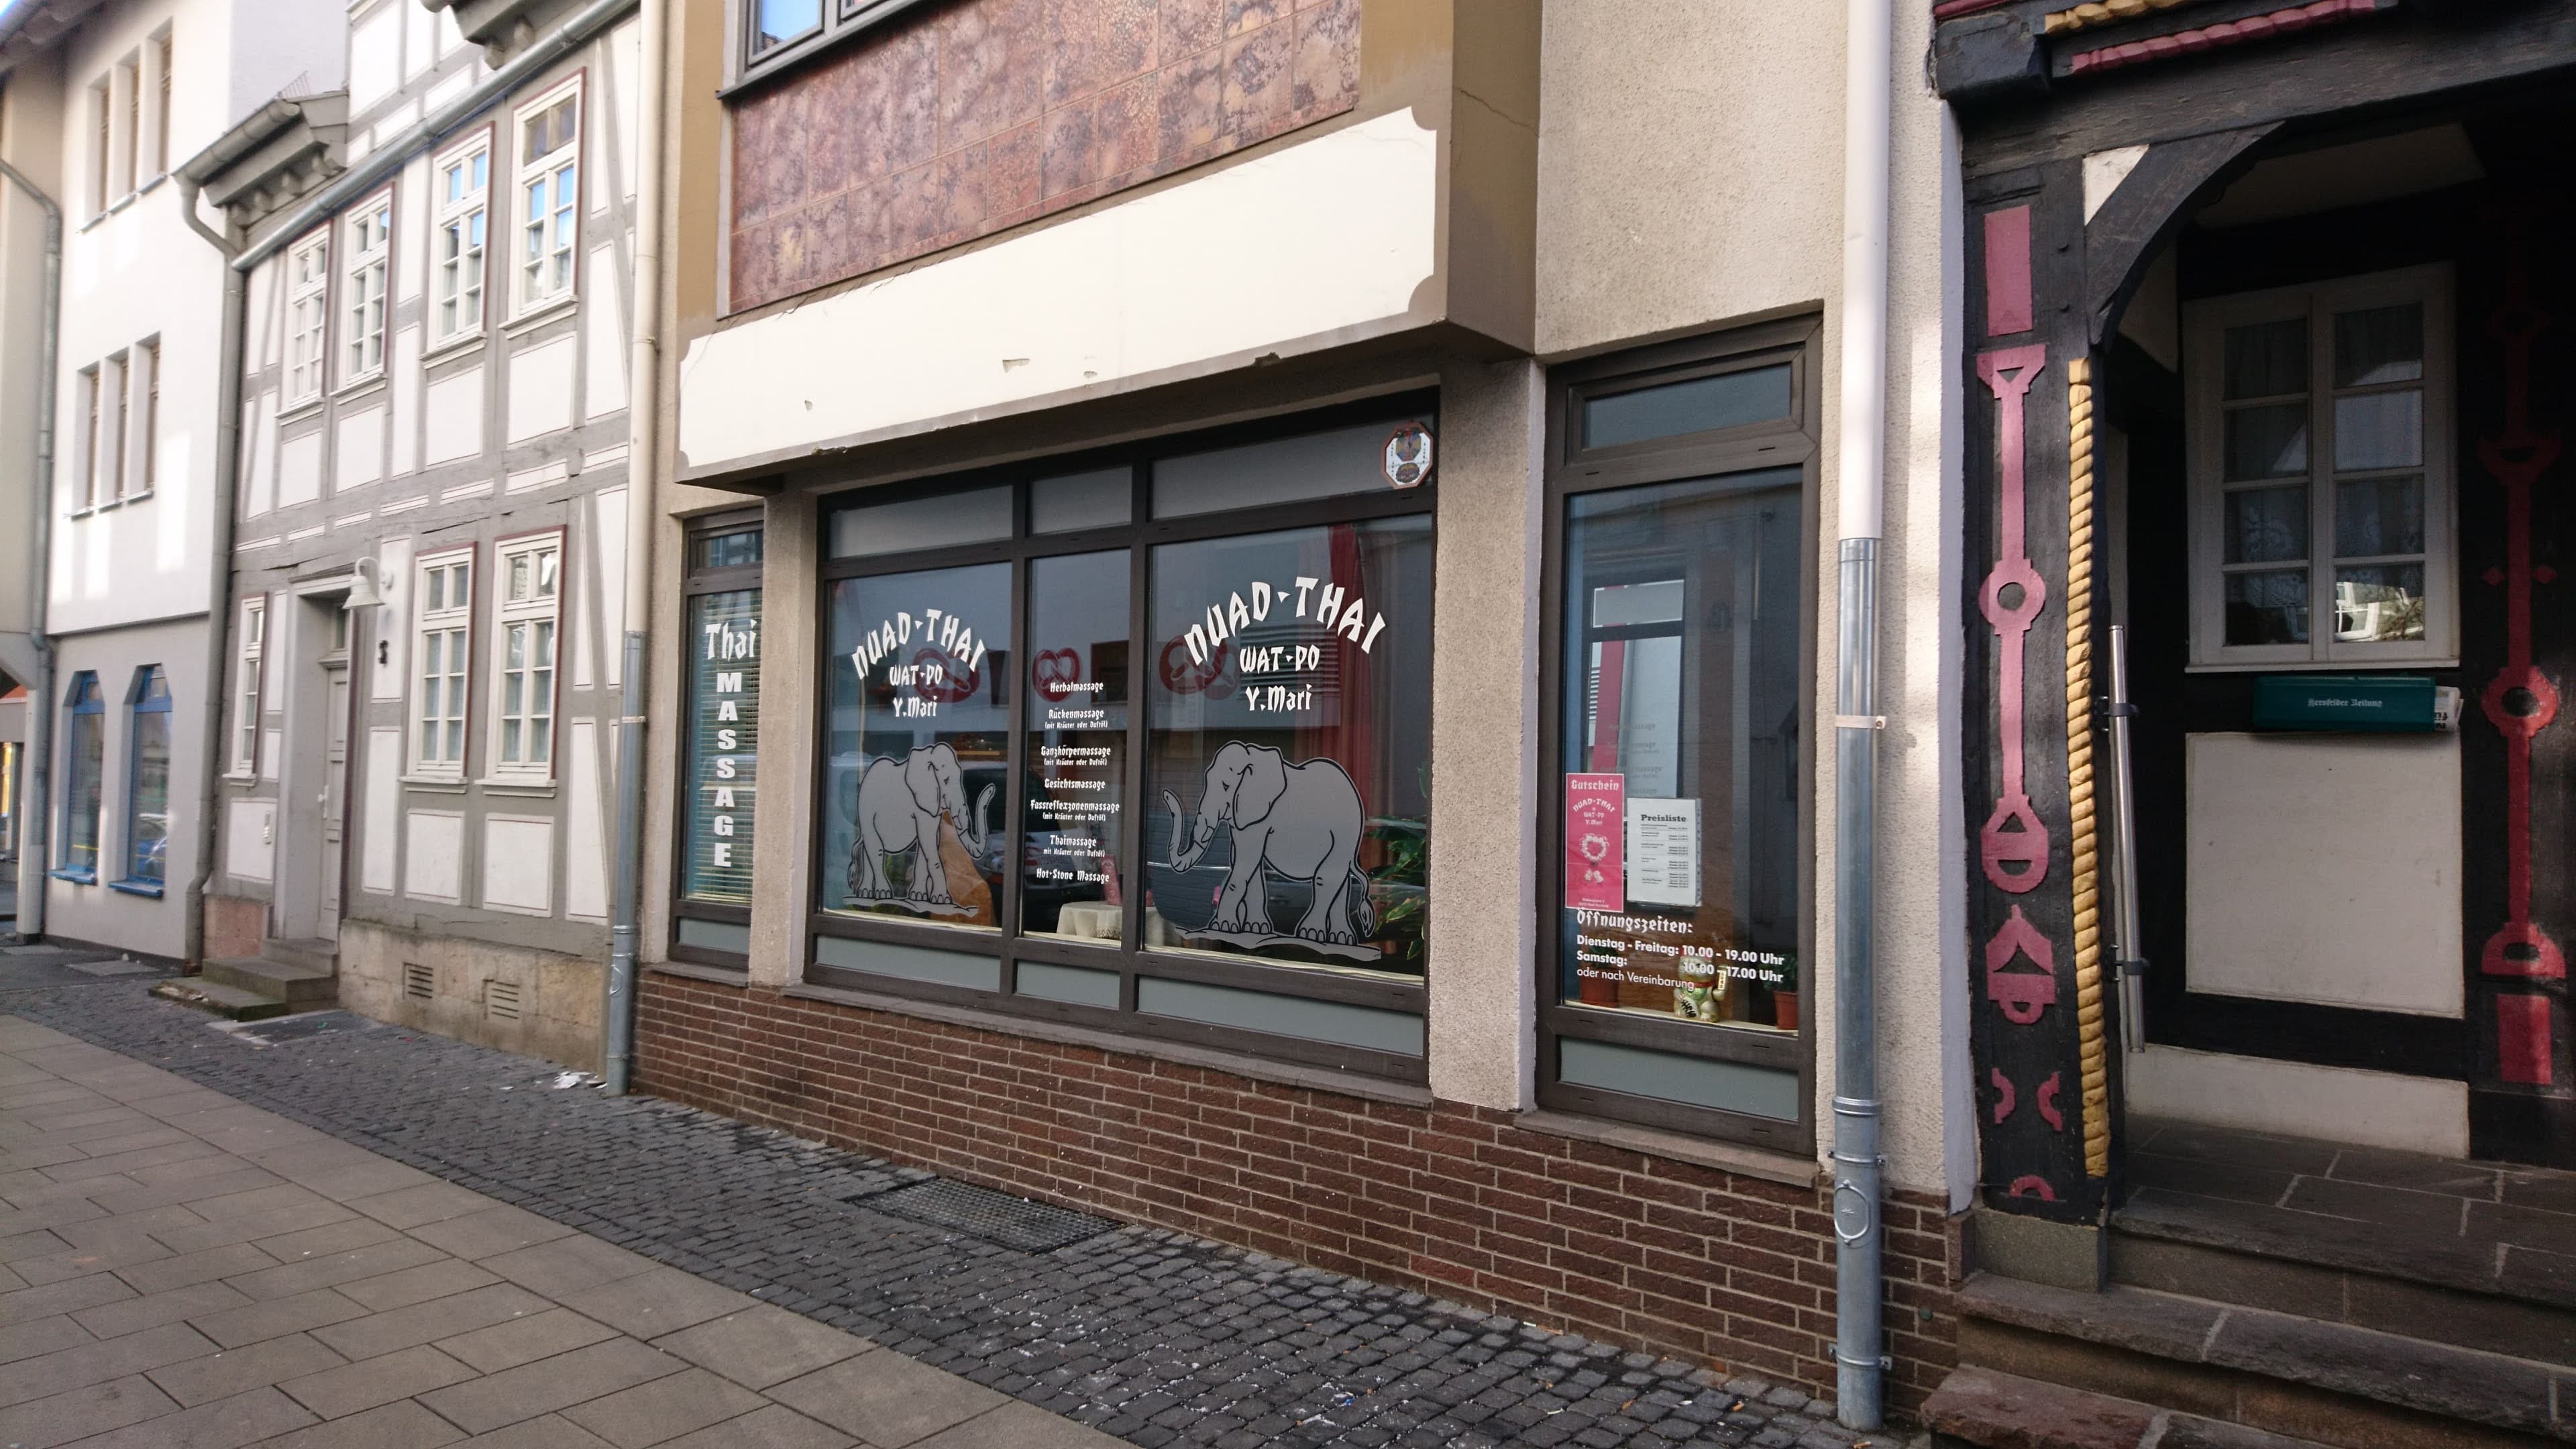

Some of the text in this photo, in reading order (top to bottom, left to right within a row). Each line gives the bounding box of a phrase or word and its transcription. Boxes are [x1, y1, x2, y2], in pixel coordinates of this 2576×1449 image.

[706, 619, 757, 661] Thai
[1240, 645, 1320, 674] WAT-PO
[890, 664, 943, 687] WAT-PO
[1050, 682, 1104, 693] Herbalmassage
[1049, 707, 1104, 720] Rückenmassage
[1057, 720, 1074, 729] Kräuter
[1040, 745, 1111, 758] Ganzkörpermassage
[714, 673, 742, 867] MASSAGE
[1044, 777, 1106, 792] Gesichtsmassage
[1571, 779, 1619, 790] Gutschein
[1030, 799, 1120, 814] Fussreflexzonenmassage
[1055, 812, 1073, 820] Kräuter
[1641, 814, 1686, 822] Preisliste
[1050, 835, 1097, 849] Thaimassage
[1043, 847, 1052, 855] mit
[1053, 847, 1072, 855] Kräuter
[1036, 867, 1110, 884] Hot-Stone Massage
[1577, 906, 1694, 934] Öffnungszeiten:
[1576, 934, 1625, 951] Dienstag
[1635, 940, 1679, 956] Freitag:
[1682, 945, 1713, 958] 10.00
[1725, 949, 1758, 963] 19.00
[1760, 952, 1785, 965] Uhr
[1576, 950, 1627, 967] Samstag:
[1684, 961, 1715, 975] 10.00
[1726, 966, 1757, 979] 17.00
[1759, 969, 1784, 982] Uhr
[1576, 966, 1695, 991] oder nach Vereinbarung
